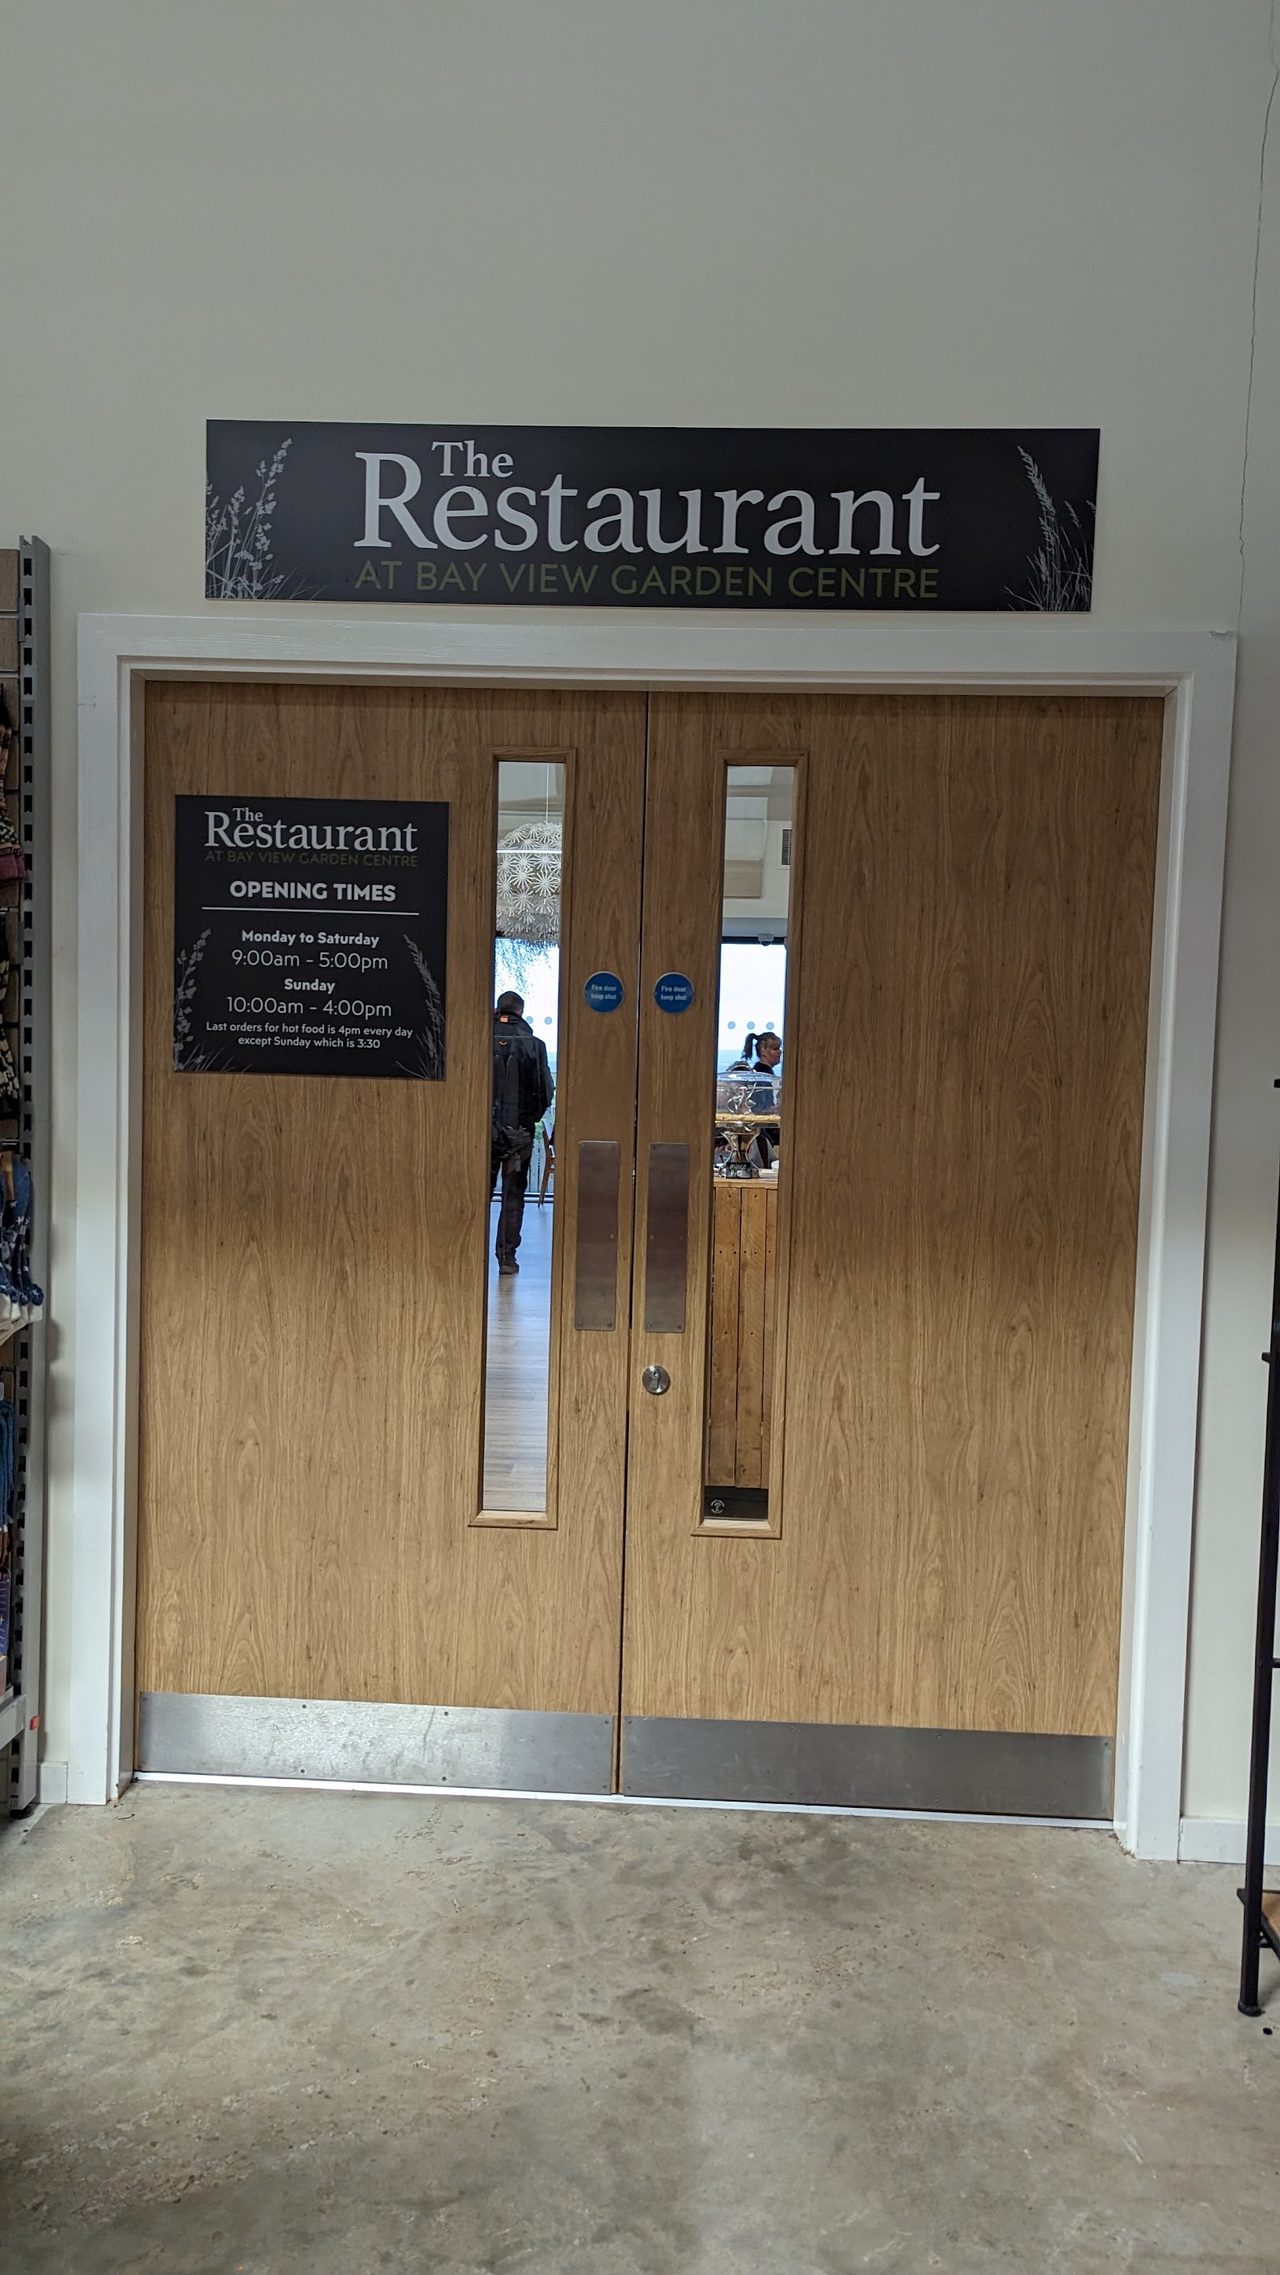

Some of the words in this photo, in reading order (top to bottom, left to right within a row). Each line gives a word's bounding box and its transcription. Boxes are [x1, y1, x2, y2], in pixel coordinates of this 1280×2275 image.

[431, 440, 514, 478] The
[353, 451, 942, 557] Restaurant
[354, 560, 402, 590] AT
[416, 561, 488, 592] BAY
[499, 564, 599, 594] VIEW
[611, 564, 773, 597] GARDEN
[788, 567, 940, 598] CENTRE
[232, 807, 264, 822] The
[204, 811, 419, 852] Restaurant
[204, 850, 222, 862] AT
[227, 851, 254, 863] BAY
[258, 852, 295, 864] VIEW
[300, 853, 359, 866] GARDEN
[363, 854, 418, 867] CENTRE
[229, 880, 328, 900] OPENING
[333, 883, 397, 902] TIMES
[241, 929, 297, 946] Monday
[299, 932, 315, 943] to
[317, 932, 380, 948] Saturday
[231, 949, 300, 967] 9:00am
[319, 952, 389, 973] 5:00pm
[284, 978, 336, 994] Sunday
[661, 985, 673, 993] Fire
[590, 993, 604, 1001] keep
[660, 994, 674, 1002] keep
[227, 996, 304, 1014] 10:00am
[322, 1000, 392, 1020] 4:00pm
[206, 1022, 228, 1031] Last
[229, 1023, 262, 1033] orders
[264, 1023, 280, 1033] for
[282, 1025, 300, 1034] hot
[301, 1024, 325, 1035] food
[327, 1026, 336, 1035] is
[338, 1027, 361, 1037] 4pm
[363, 1028, 392, 1038] every
[394, 1027, 414, 1039] day
[238, 1037, 272, 1047] except
[273, 1037, 311, 1049] Sunday
[313, 1038, 344, 1049] which
[346, 1038, 355, 1049] is
[357, 1039, 381, 1049] 3:30
